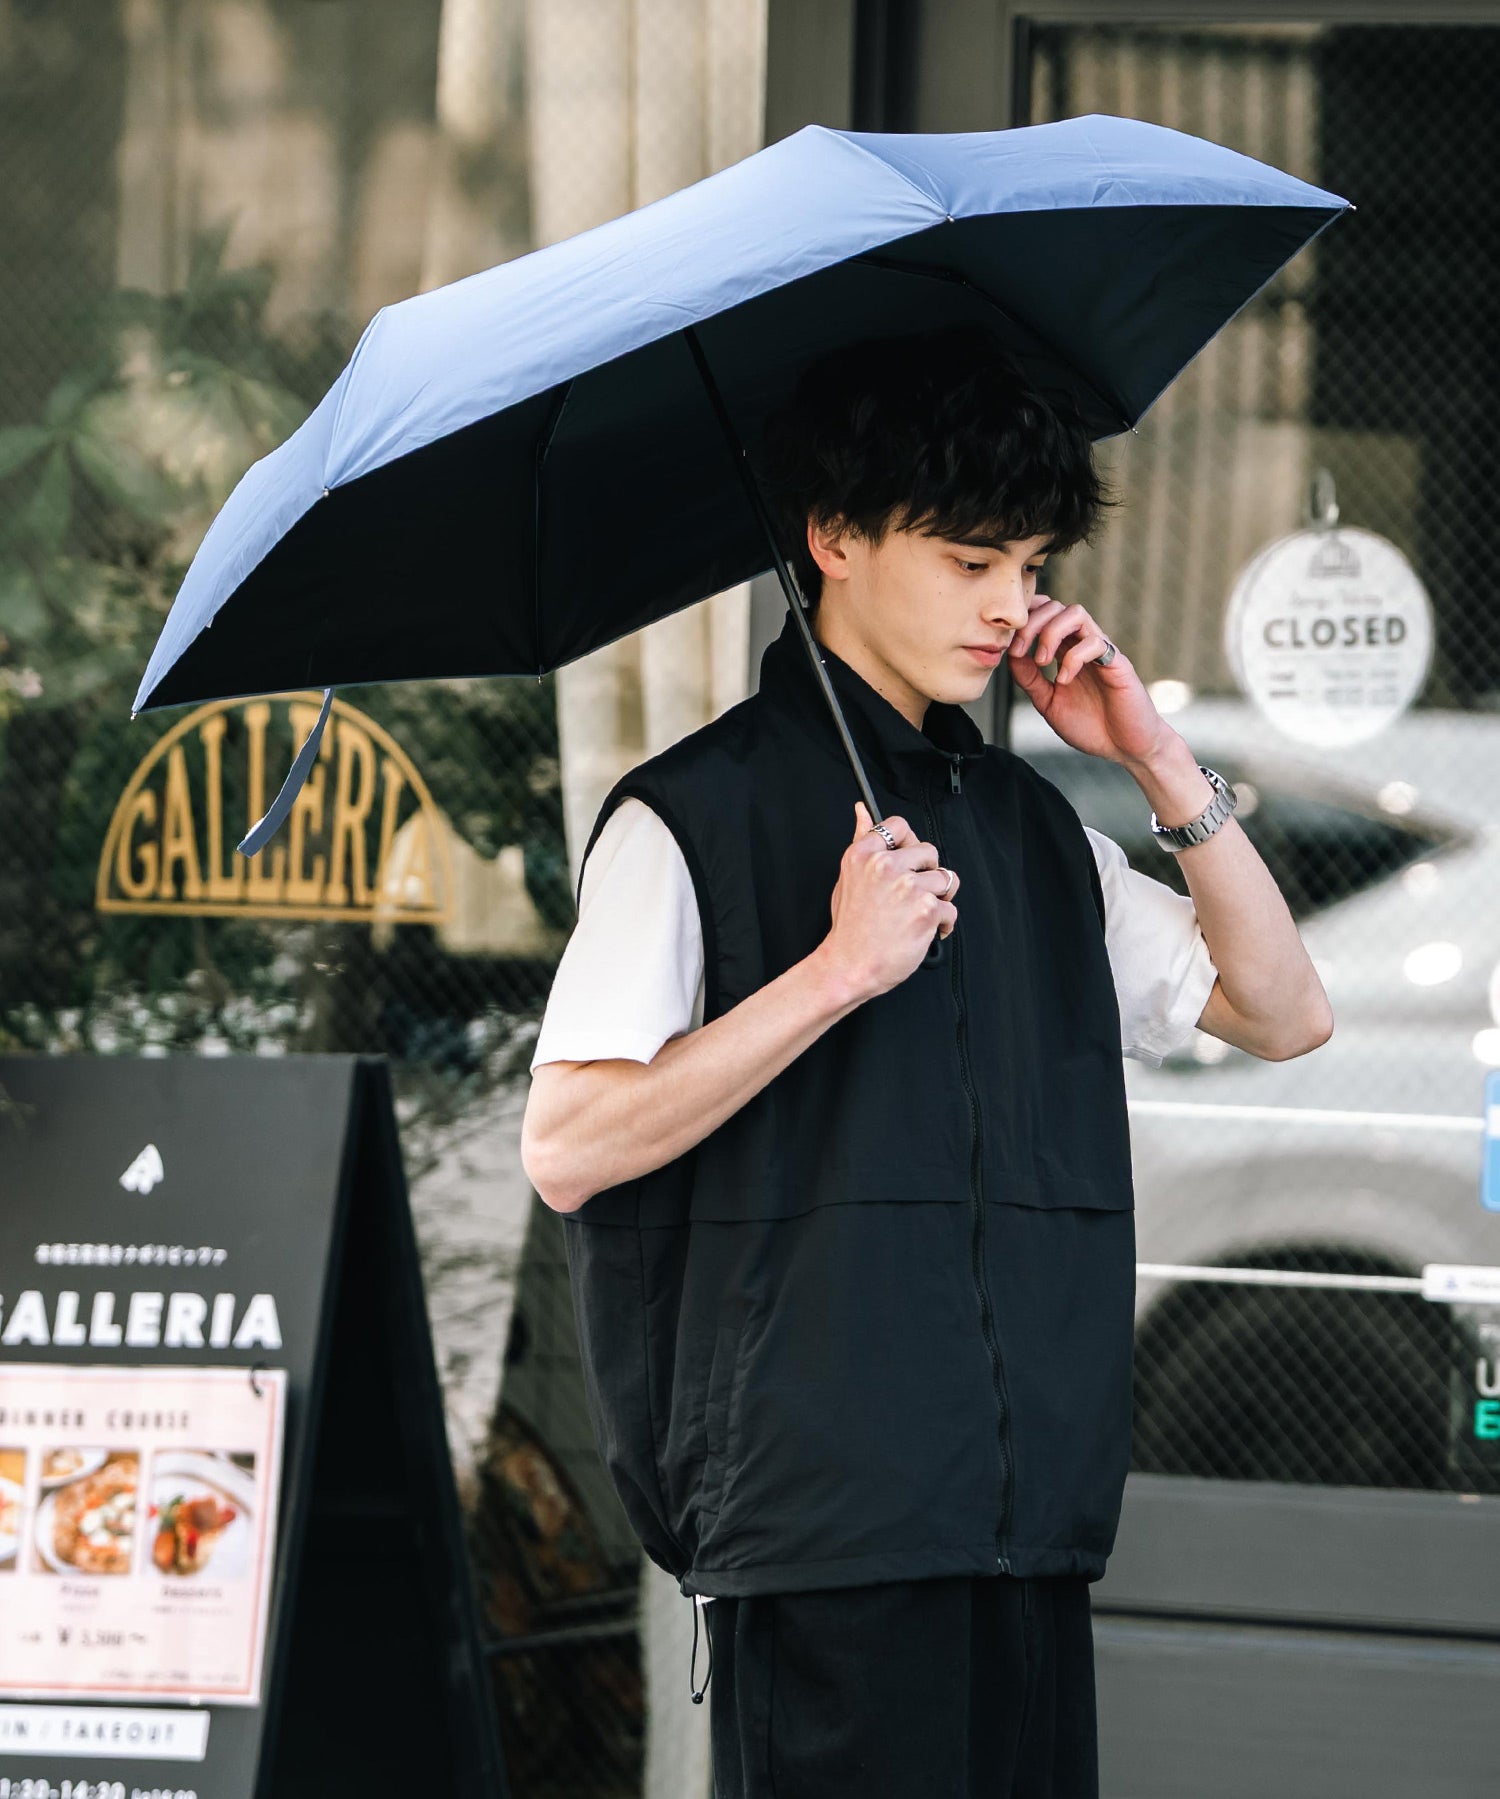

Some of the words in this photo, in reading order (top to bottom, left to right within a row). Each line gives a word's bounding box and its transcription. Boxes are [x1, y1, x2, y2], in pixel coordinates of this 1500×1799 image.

[1261, 615, 1408, 650] CLOSED
[116, 700, 437, 908] GALLERIA
[0, 1289, 284, 1350] ALLERIA
[62, 1719, 176, 1745] TAKEOUT
